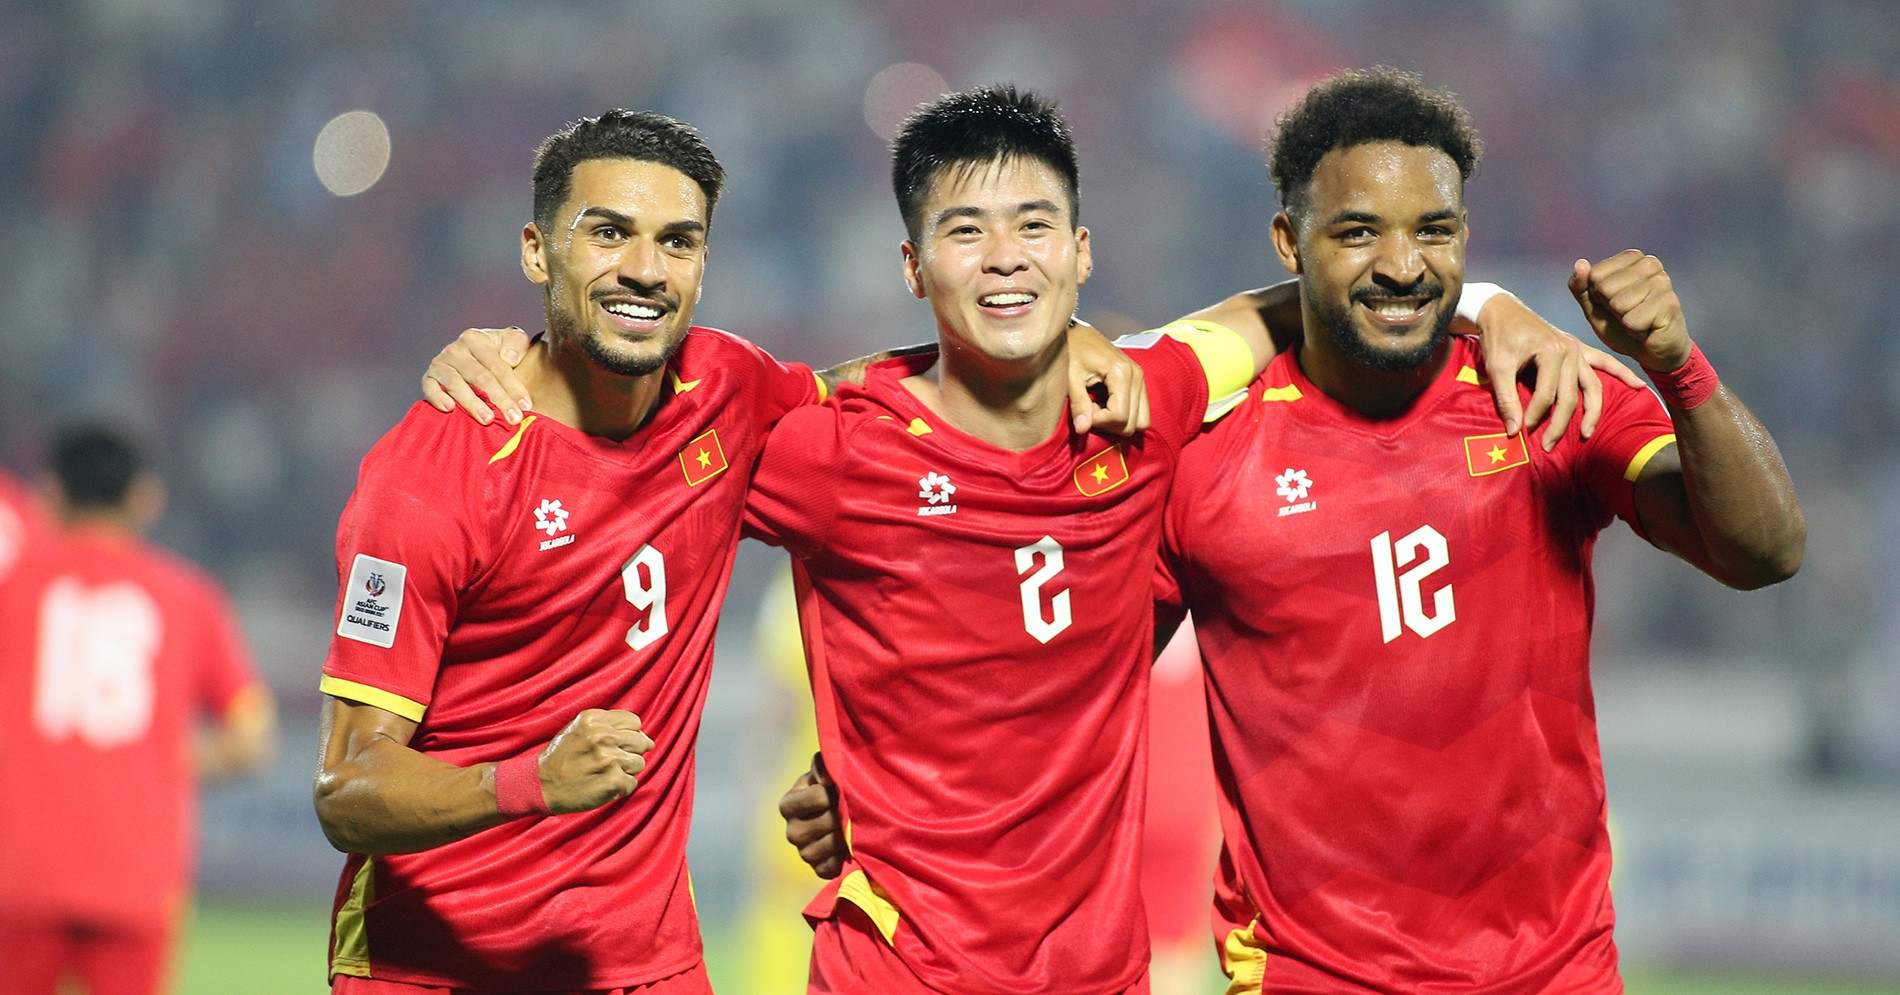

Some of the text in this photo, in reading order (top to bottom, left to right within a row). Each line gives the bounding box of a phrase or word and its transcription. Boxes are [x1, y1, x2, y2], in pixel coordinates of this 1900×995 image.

[347, 615, 390, 631] QUALIFIERS
[357, 601, 373, 609] ASIAN
[621, 542, 669, 652] 9
[1014, 534, 1073, 645] 2
[1371, 525, 1457, 643] 12
